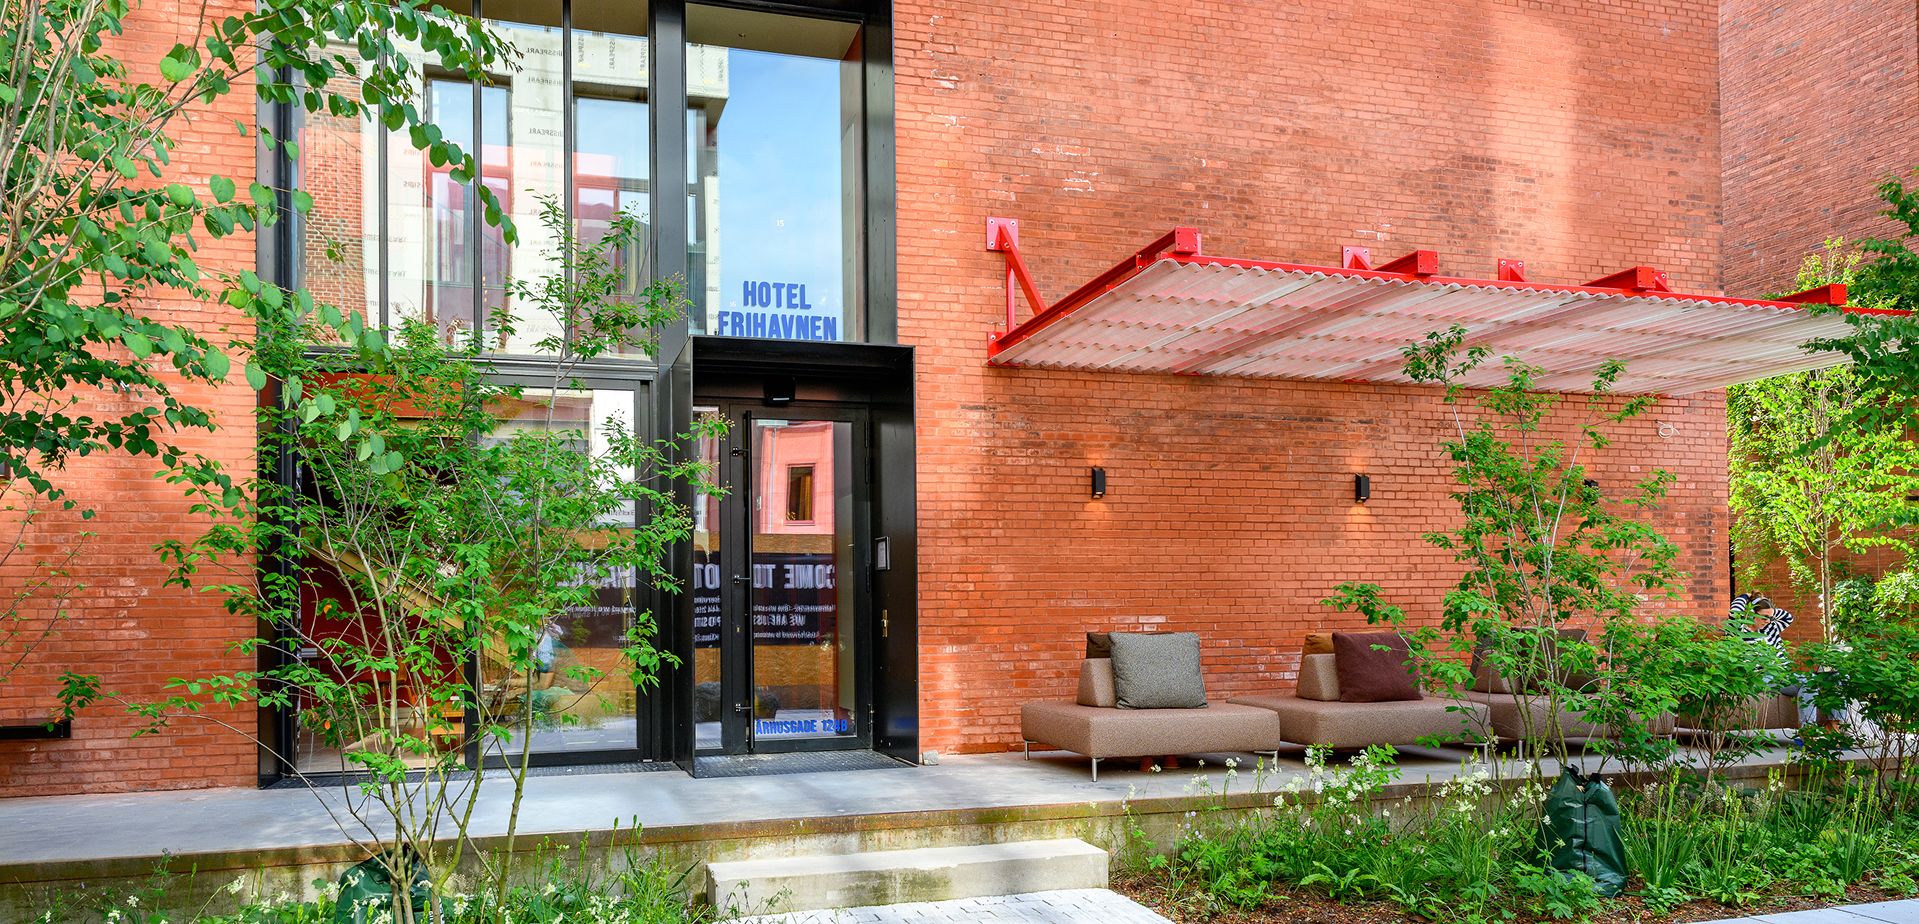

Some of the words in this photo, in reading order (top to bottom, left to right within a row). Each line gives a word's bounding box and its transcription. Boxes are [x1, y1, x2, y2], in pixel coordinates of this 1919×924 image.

[743, 280, 811, 310] HOTEL
[718, 310, 837, 341] FRIHAVNEN
[755, 718, 817, 735] ÅRHUSGADE
[821, 718, 848, 733] 124B
